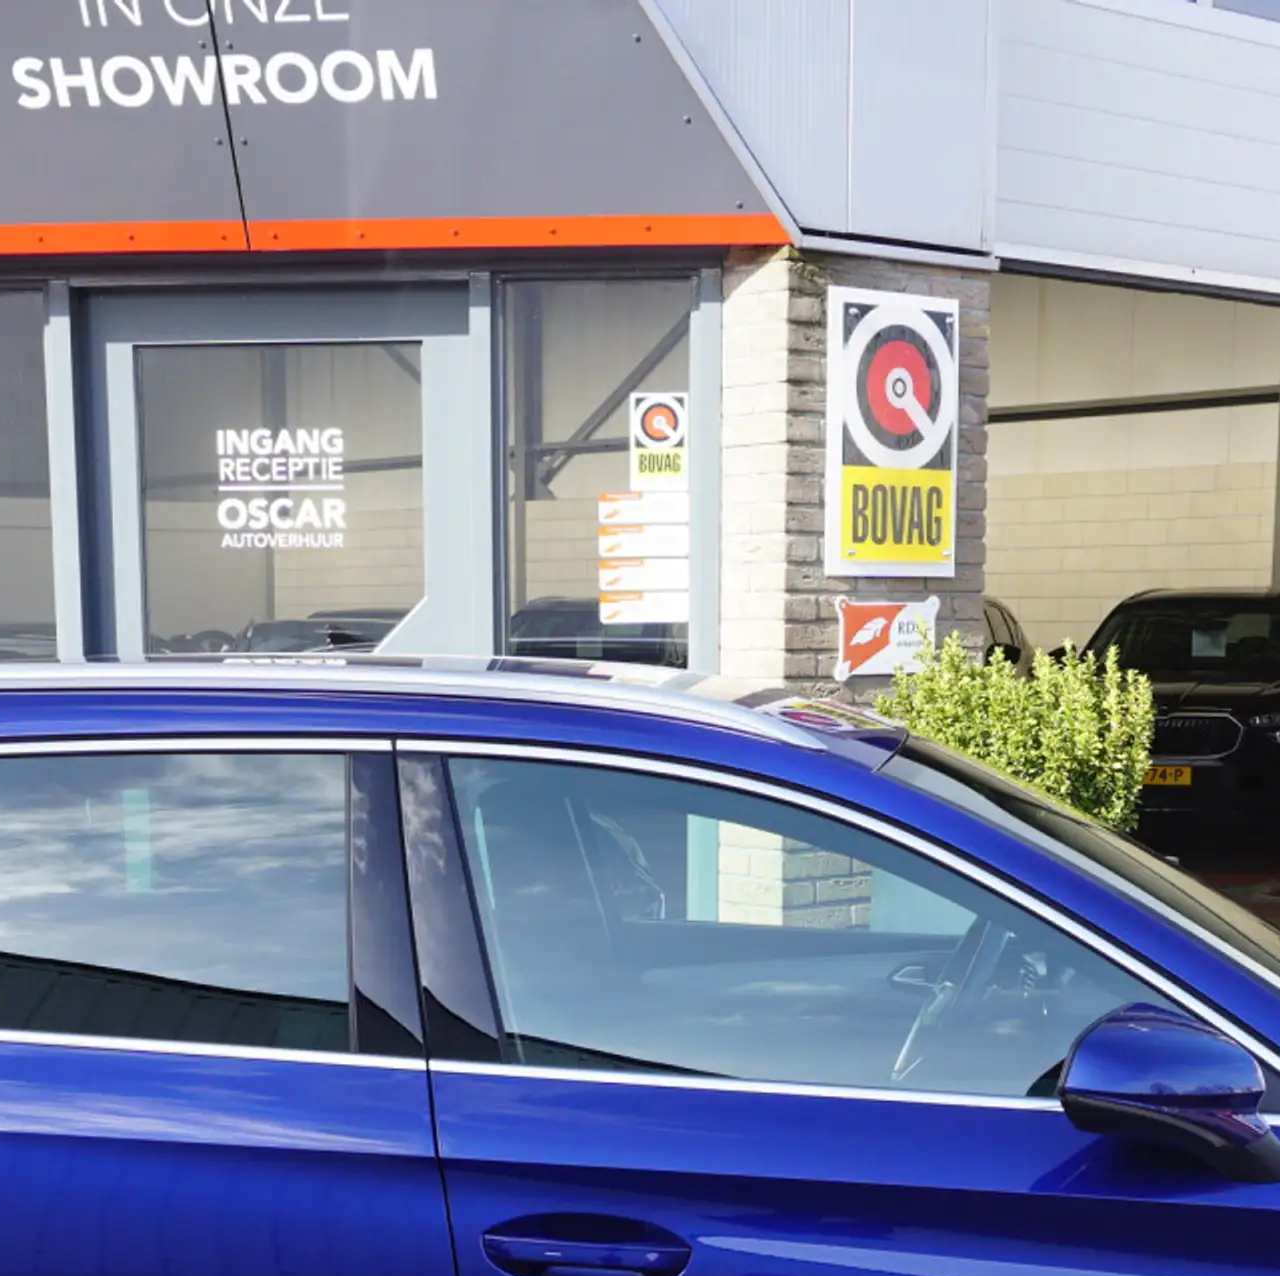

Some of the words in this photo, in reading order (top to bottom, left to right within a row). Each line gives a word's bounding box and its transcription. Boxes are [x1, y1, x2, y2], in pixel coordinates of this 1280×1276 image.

[11, 48, 438, 110] SHOWROOM
[216, 428, 344, 455] INGANG
[219, 457, 344, 481] RECEPTIE
[638, 453, 682, 474] BOVAG
[218, 498, 346, 530] OSCAR
[851, 483, 943, 546] BOVAG
[221, 532, 344, 548] AUTOVERHUUR
